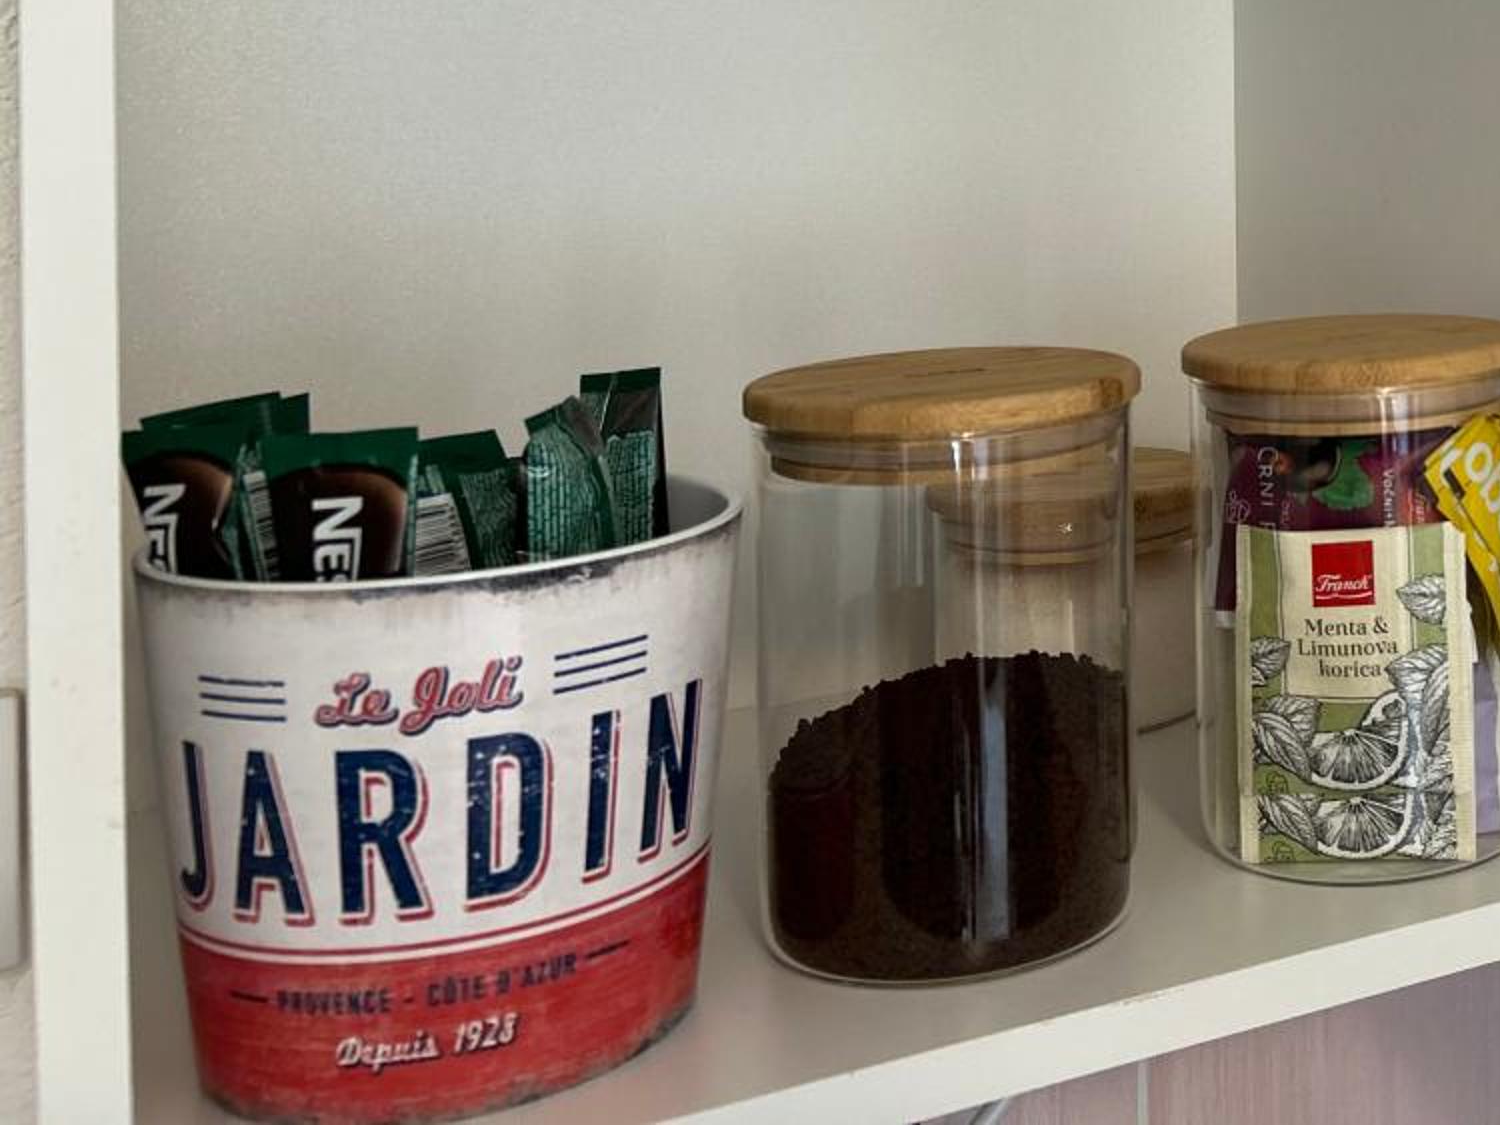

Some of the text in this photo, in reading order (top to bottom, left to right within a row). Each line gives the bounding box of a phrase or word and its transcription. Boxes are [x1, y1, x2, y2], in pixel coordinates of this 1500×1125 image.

[1304, 616, 1389, 636] Menta &
[1298, 638, 1399, 657] Limunova
[1319, 659, 1382, 678] korica
[315, 656, 524, 736] Le Joli
[181, 678, 704, 927] JARDIN
[277, 989, 392, 1016] PROVENCE
[427, 975, 486, 1008] CÔTE
[336, 1030, 440, 1073] Depuis
